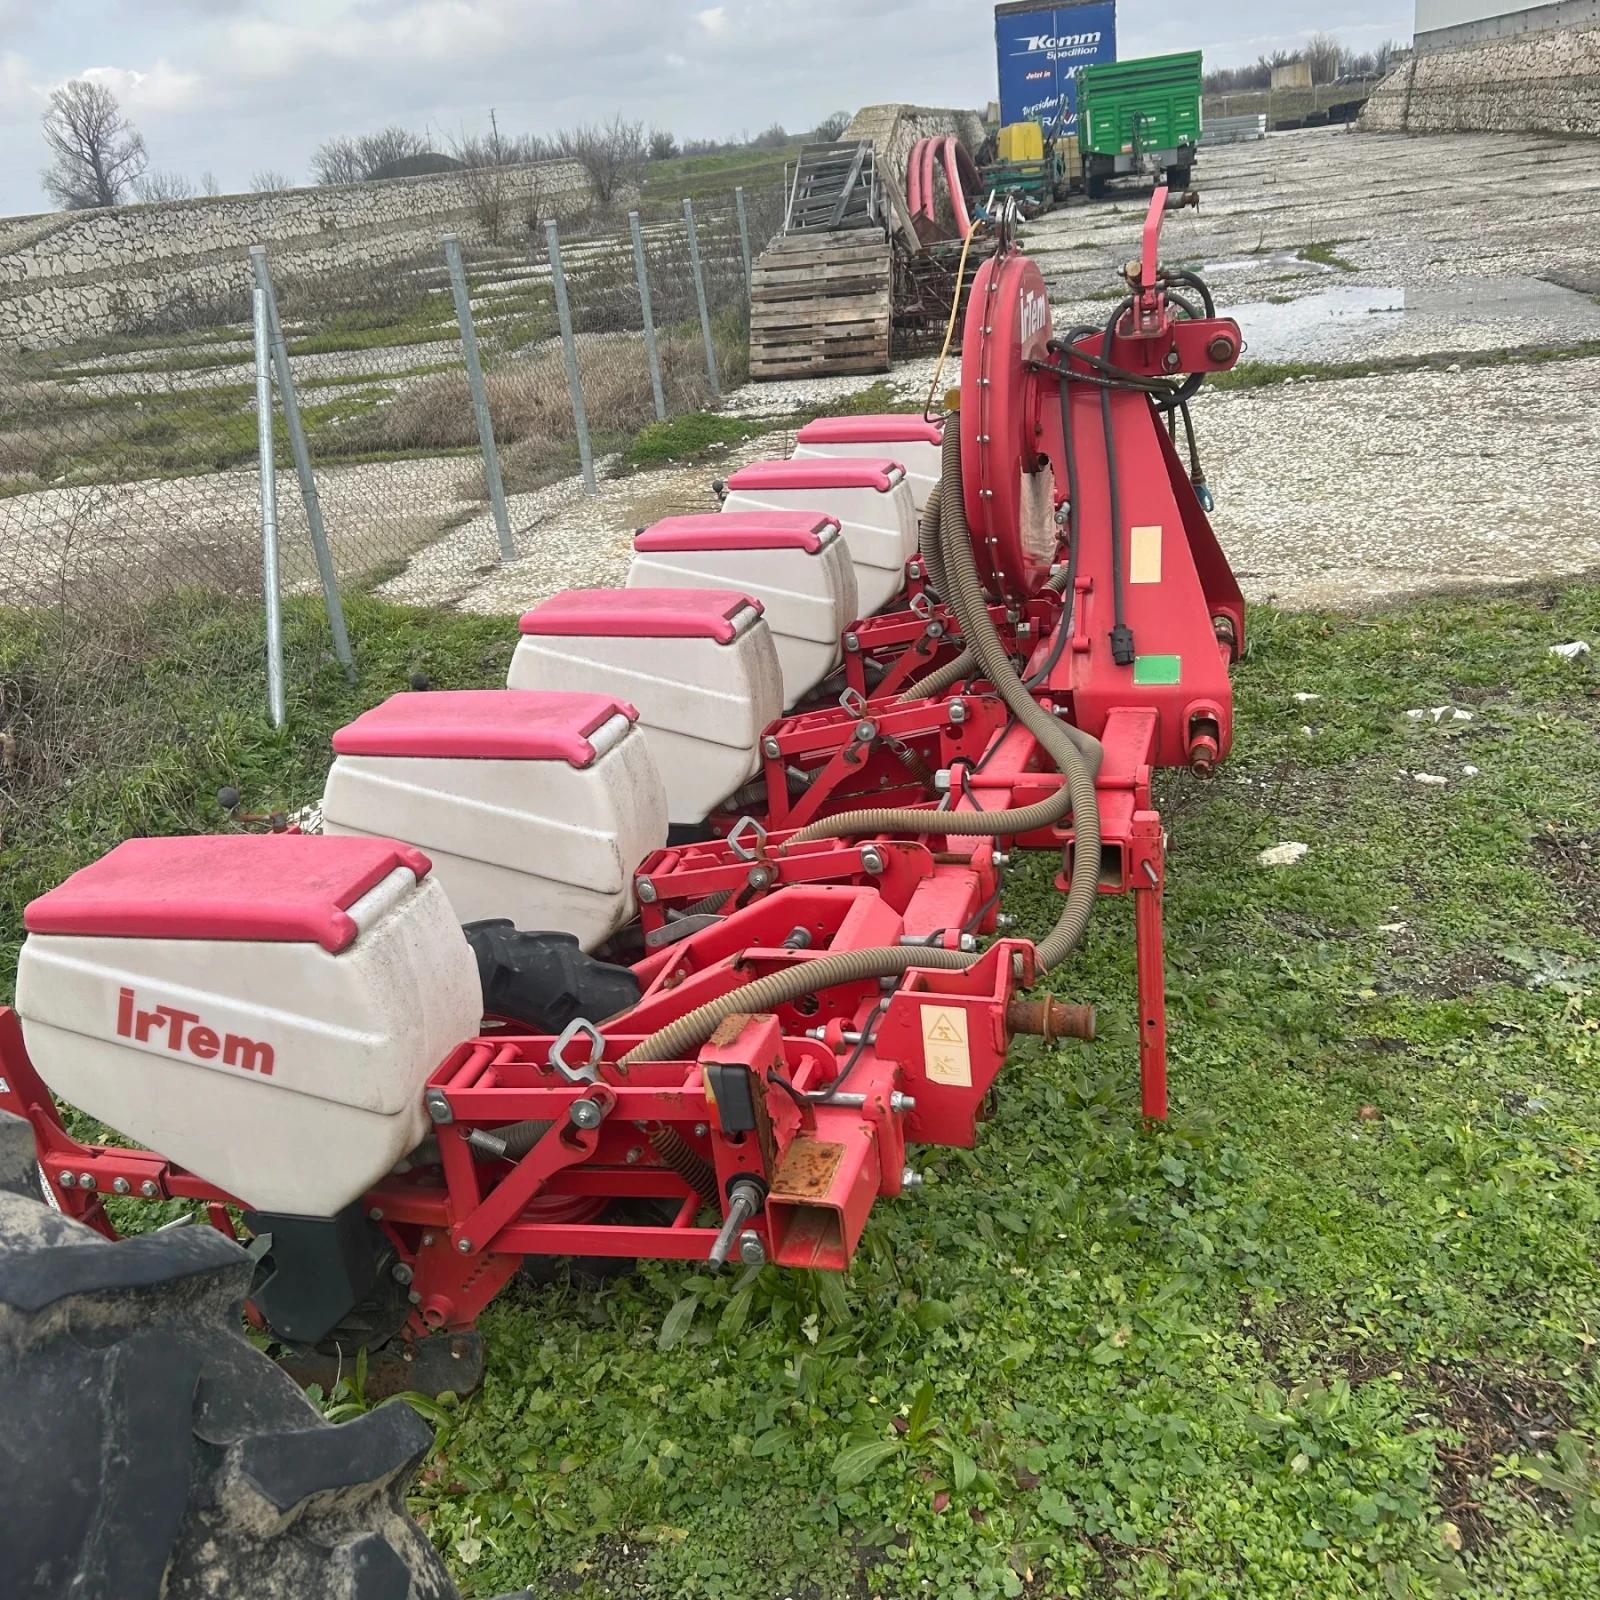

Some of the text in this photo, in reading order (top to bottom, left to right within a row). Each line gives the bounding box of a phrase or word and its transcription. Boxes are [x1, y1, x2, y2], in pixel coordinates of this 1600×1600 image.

[1027, 31, 1101, 51] Komm
[1046, 46, 1098, 60] Spedition
[1043, 70, 1051, 78] in
